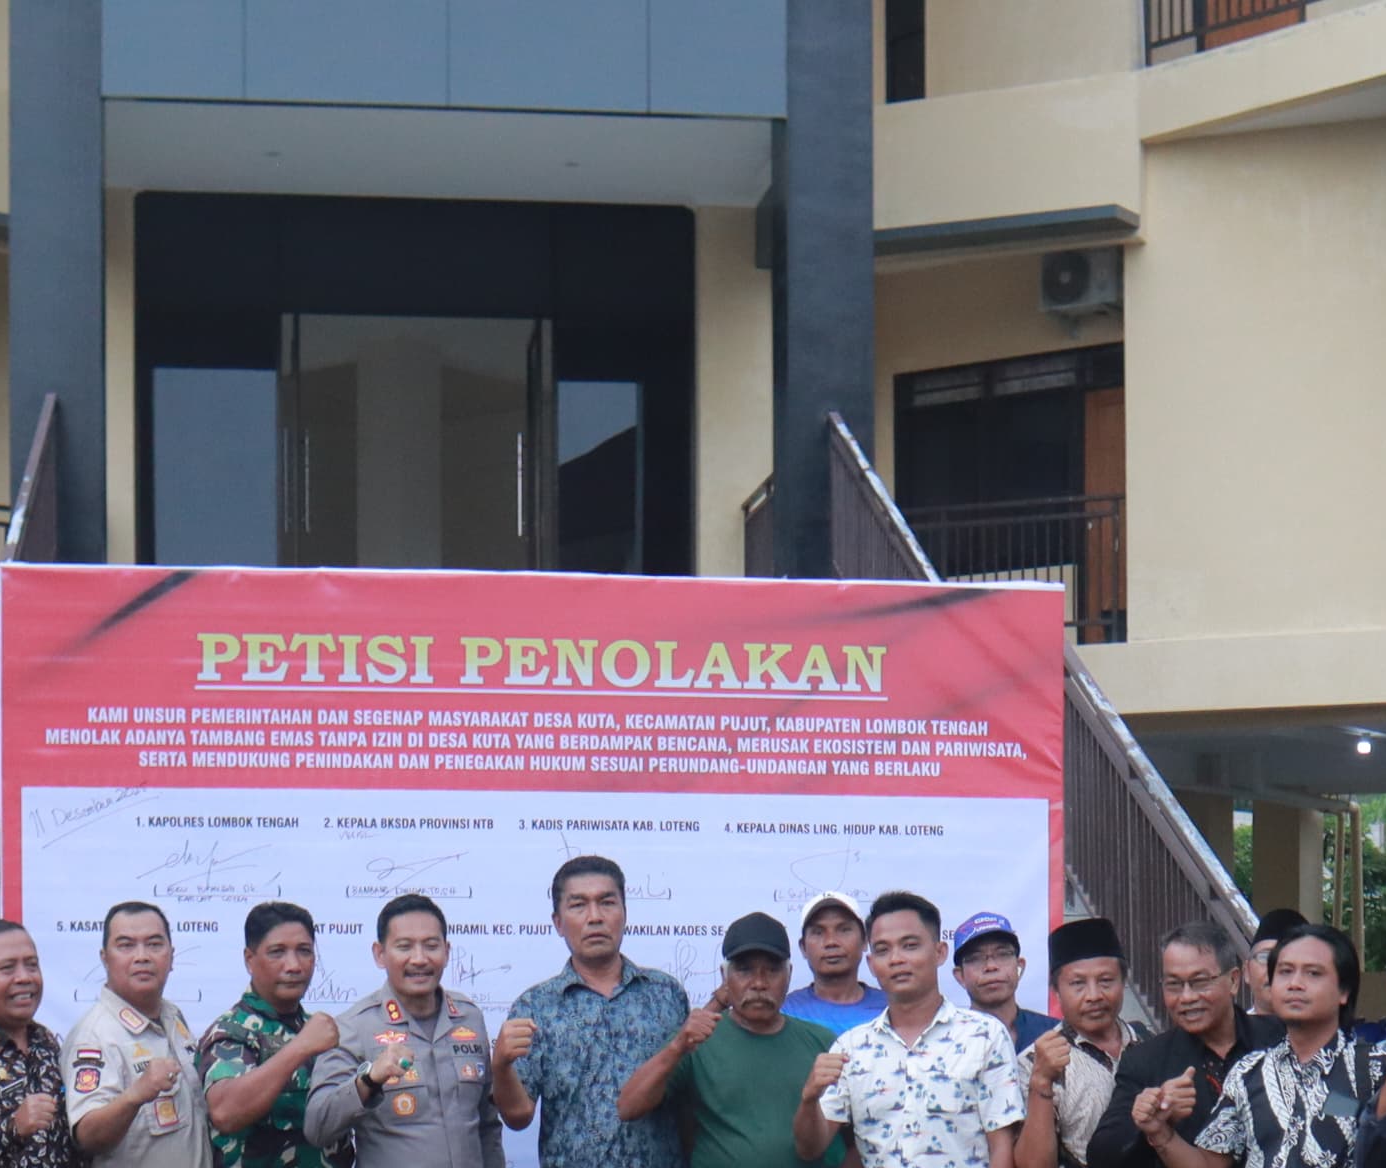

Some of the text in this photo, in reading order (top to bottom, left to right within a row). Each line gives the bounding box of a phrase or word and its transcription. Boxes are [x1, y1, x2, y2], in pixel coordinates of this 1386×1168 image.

[196, 633, 887, 693] PETISI PENOLAKAN
[88, 707, 988, 736] KAMI UNSUR PEMERINTAHAN DAN SEGENAP MASYARAKAT DESA KUTA, KECAMATAN PUJUT, KABUPATEN LOMBOK TENGAH
[45, 729, 1028, 761] MENOLAK ADANYA TAMBANG EMAS TANPA IZIN DI DESA KUTA YANG BERDAMPAK BENCANA, MERUSAK EKOSISTEM DAN PARIWISATA,
[139, 751, 941, 777] SERTA MENDUKUNG PENINDAKAN DAN PENEGAKAN HUKUM SESUAI PERUNDANG-UNDANGAN YANG BERLAKU
[135, 816, 299, 829] 1. KAPOLRES LOMBOK TENGAH
[324, 817, 494, 830] 2. KEPALA BKSDA PROVINSI NTB
[518, 819, 700, 833] 3. KADIS PARIWISATA KAB. LOTENG
[724, 822, 944, 837] 4. KEPALA DINAS LING. HIDUP KAB. LOTENG
[56, 920, 67, 932] 5.
[176, 921, 219, 933] LOTENG
[328, 923, 363, 935] PUJUT
[447, 923, 553, 936] NRAMIL KEC. PUJUT
[624, 924, 671, 937] WAKILAN
[673, 925, 708, 937] KADES
[452, 1044, 483, 1055] POLRI
